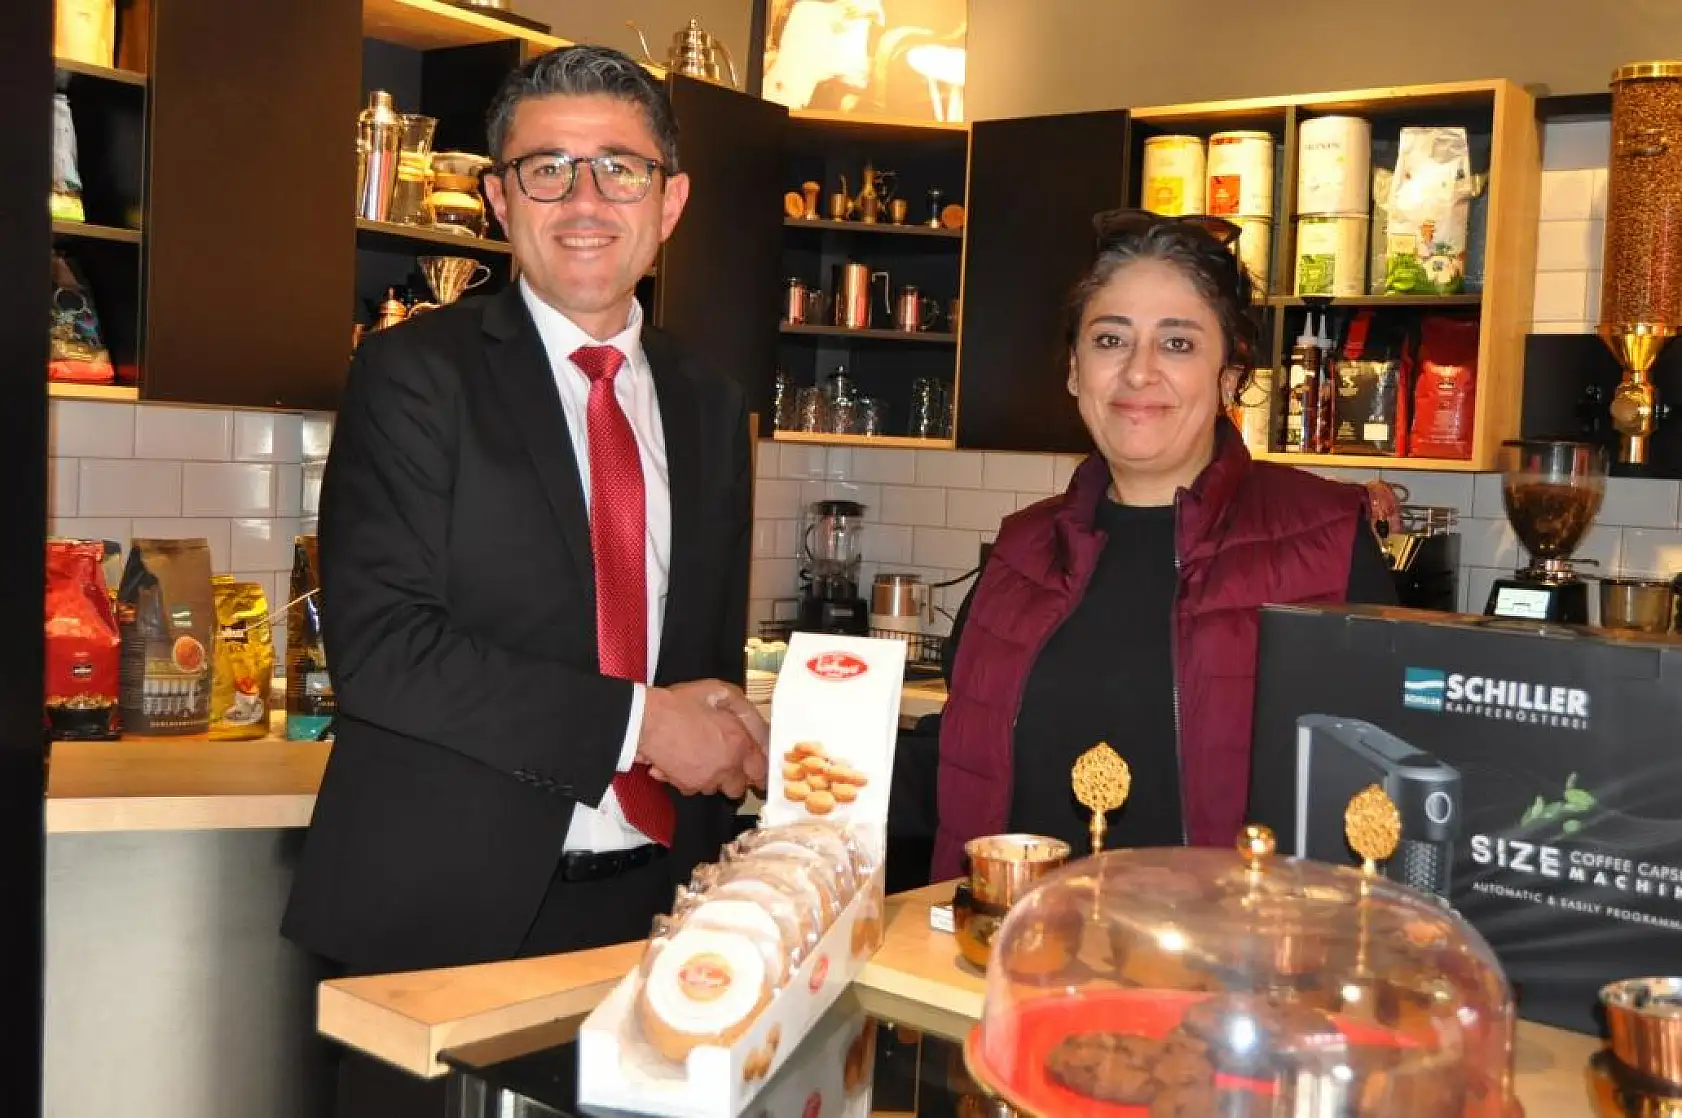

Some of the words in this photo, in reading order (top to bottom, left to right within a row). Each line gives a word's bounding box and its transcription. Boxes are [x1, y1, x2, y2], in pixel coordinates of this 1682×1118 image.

[1447, 673, 1590, 717] SCHILLER
[1471, 834, 1561, 877] SIZE
[1570, 851, 1632, 873] COFFEE
[1637, 862, 1682, 882] CAPS
[1472, 881, 1542, 903] AUTOMATIC
[1560, 898, 1600, 914] EASILY
